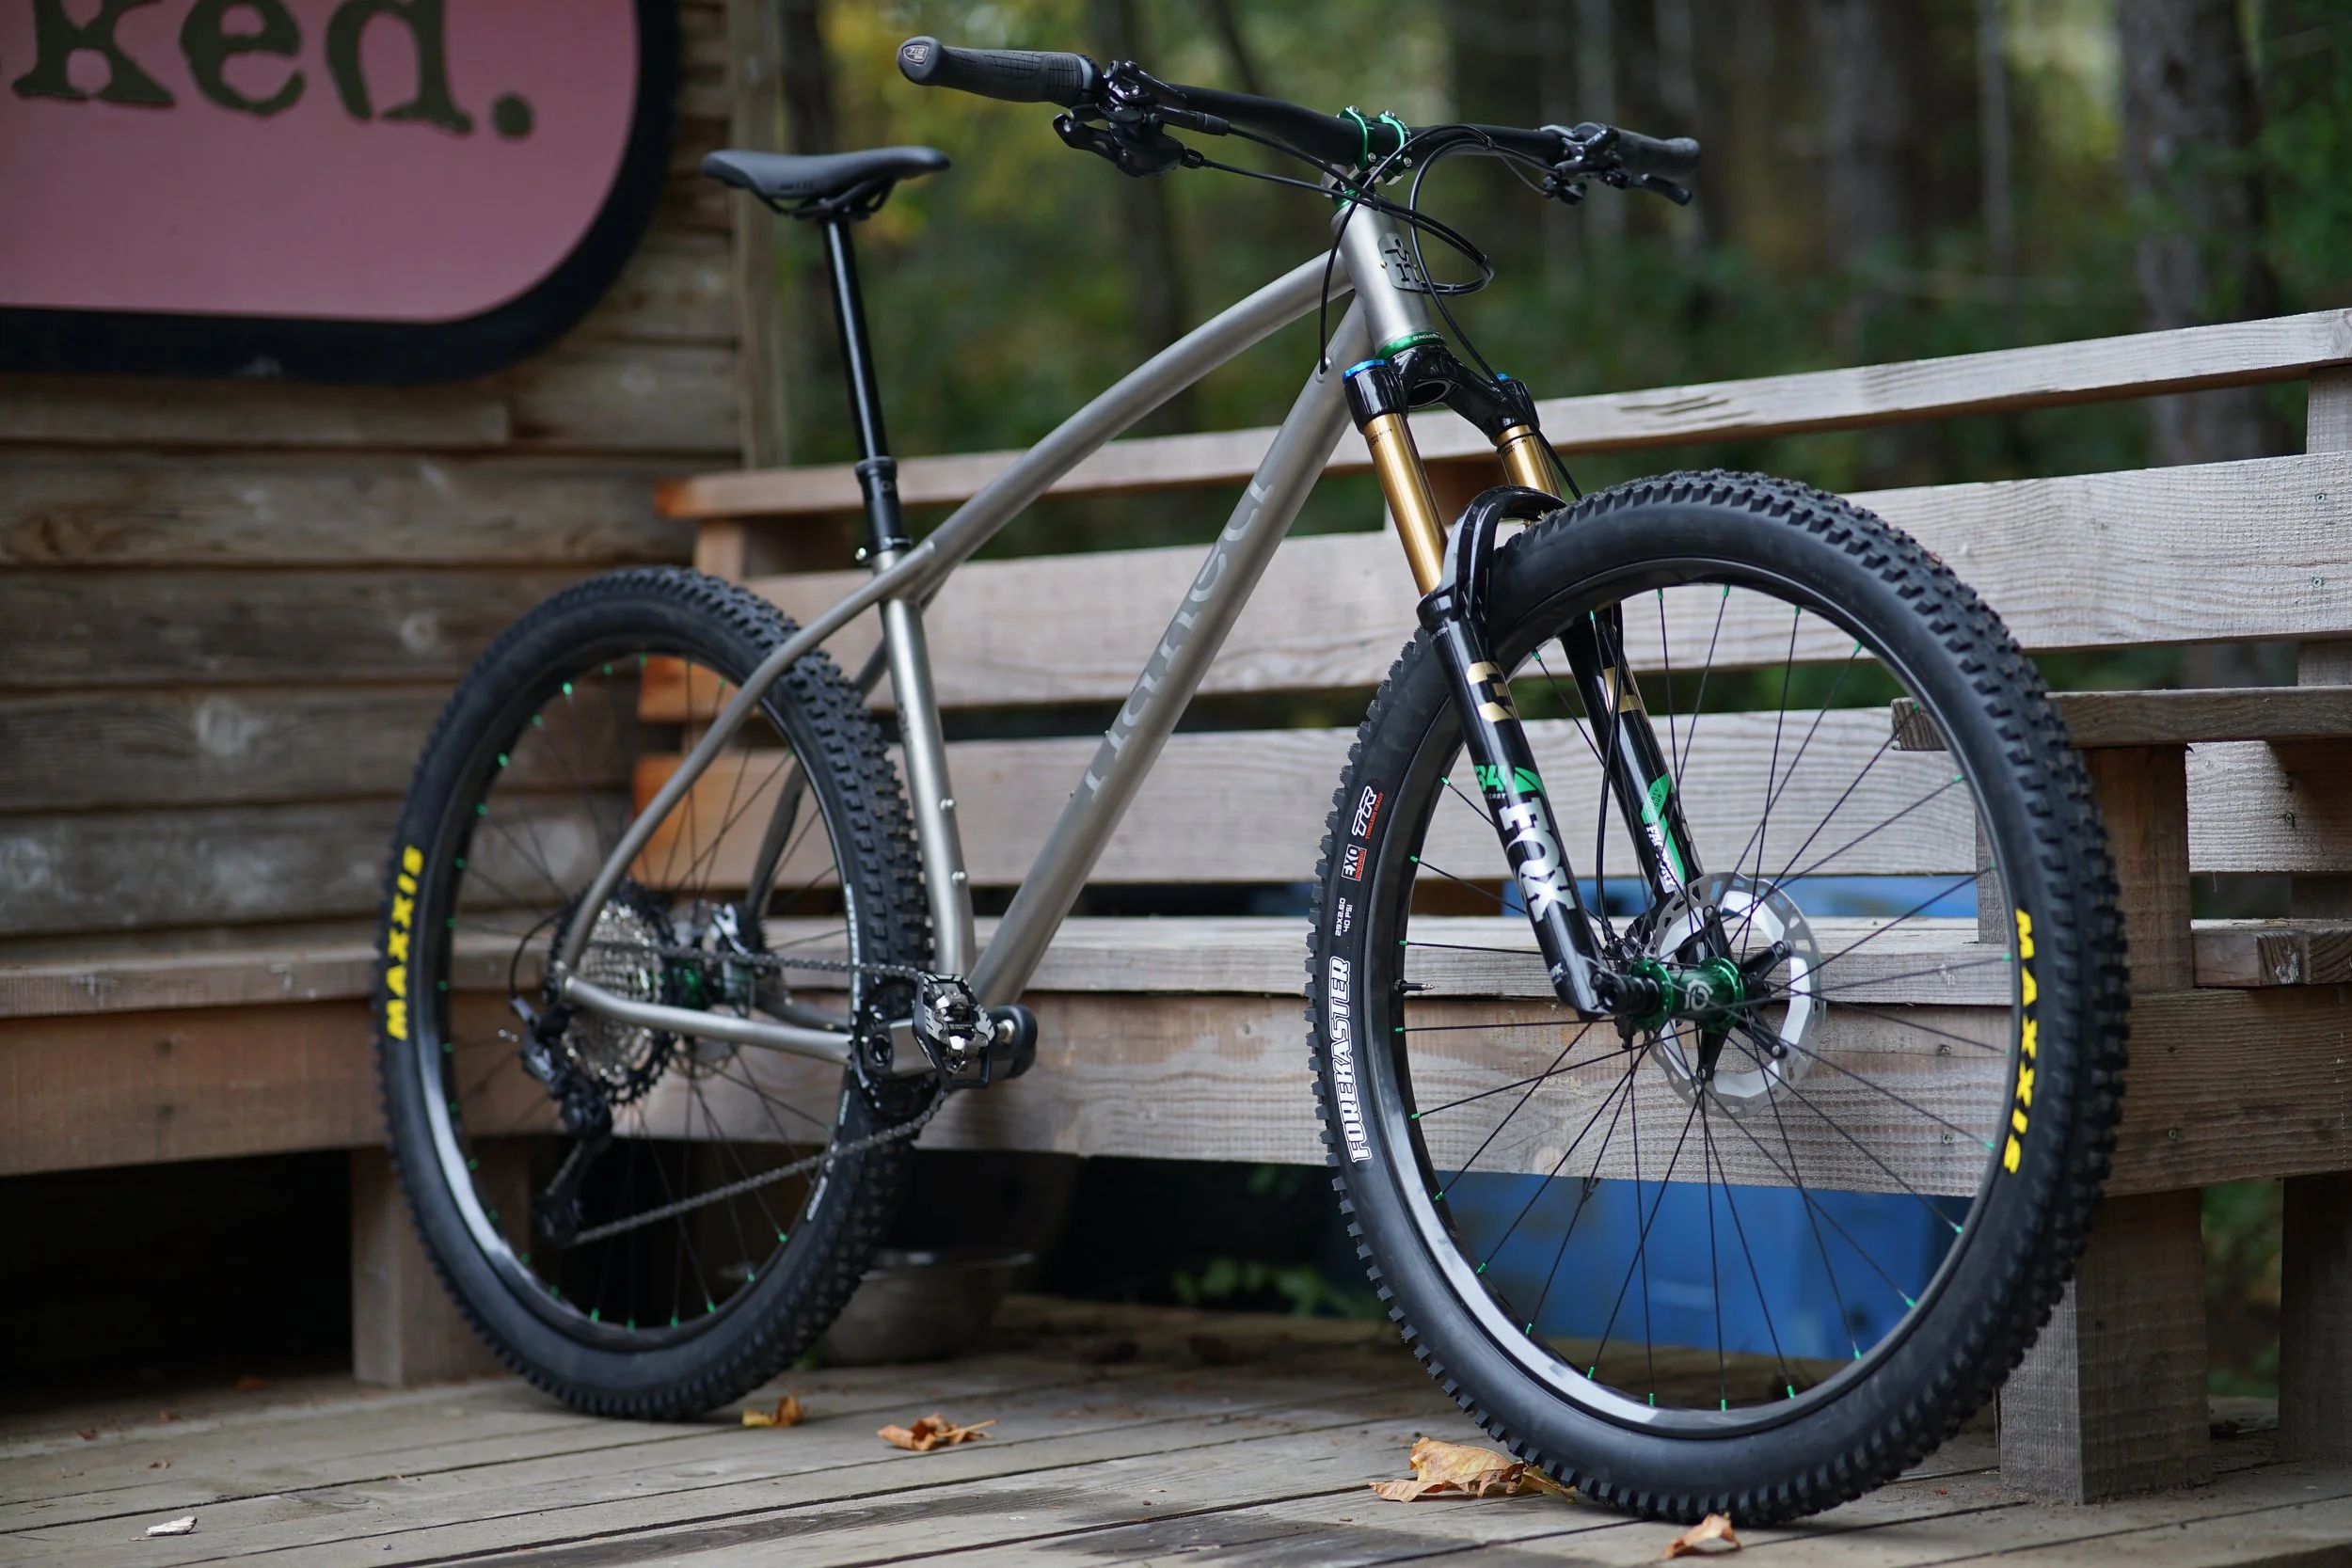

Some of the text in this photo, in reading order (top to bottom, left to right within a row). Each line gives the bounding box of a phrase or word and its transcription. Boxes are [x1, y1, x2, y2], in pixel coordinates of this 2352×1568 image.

[1351, 785, 1376, 836] TR
[1475, 765, 1507, 792] 34
[1343, 846, 1360, 877] EXO
[1498, 797, 1577, 923] FOX
[385, 845, 423, 1040] MAXXIS
[1343, 904, 1353, 932] 40 PSI
[1328, 956, 1373, 1163] FOREKASTER
[2003, 908, 2038, 1174] MAXXIS
